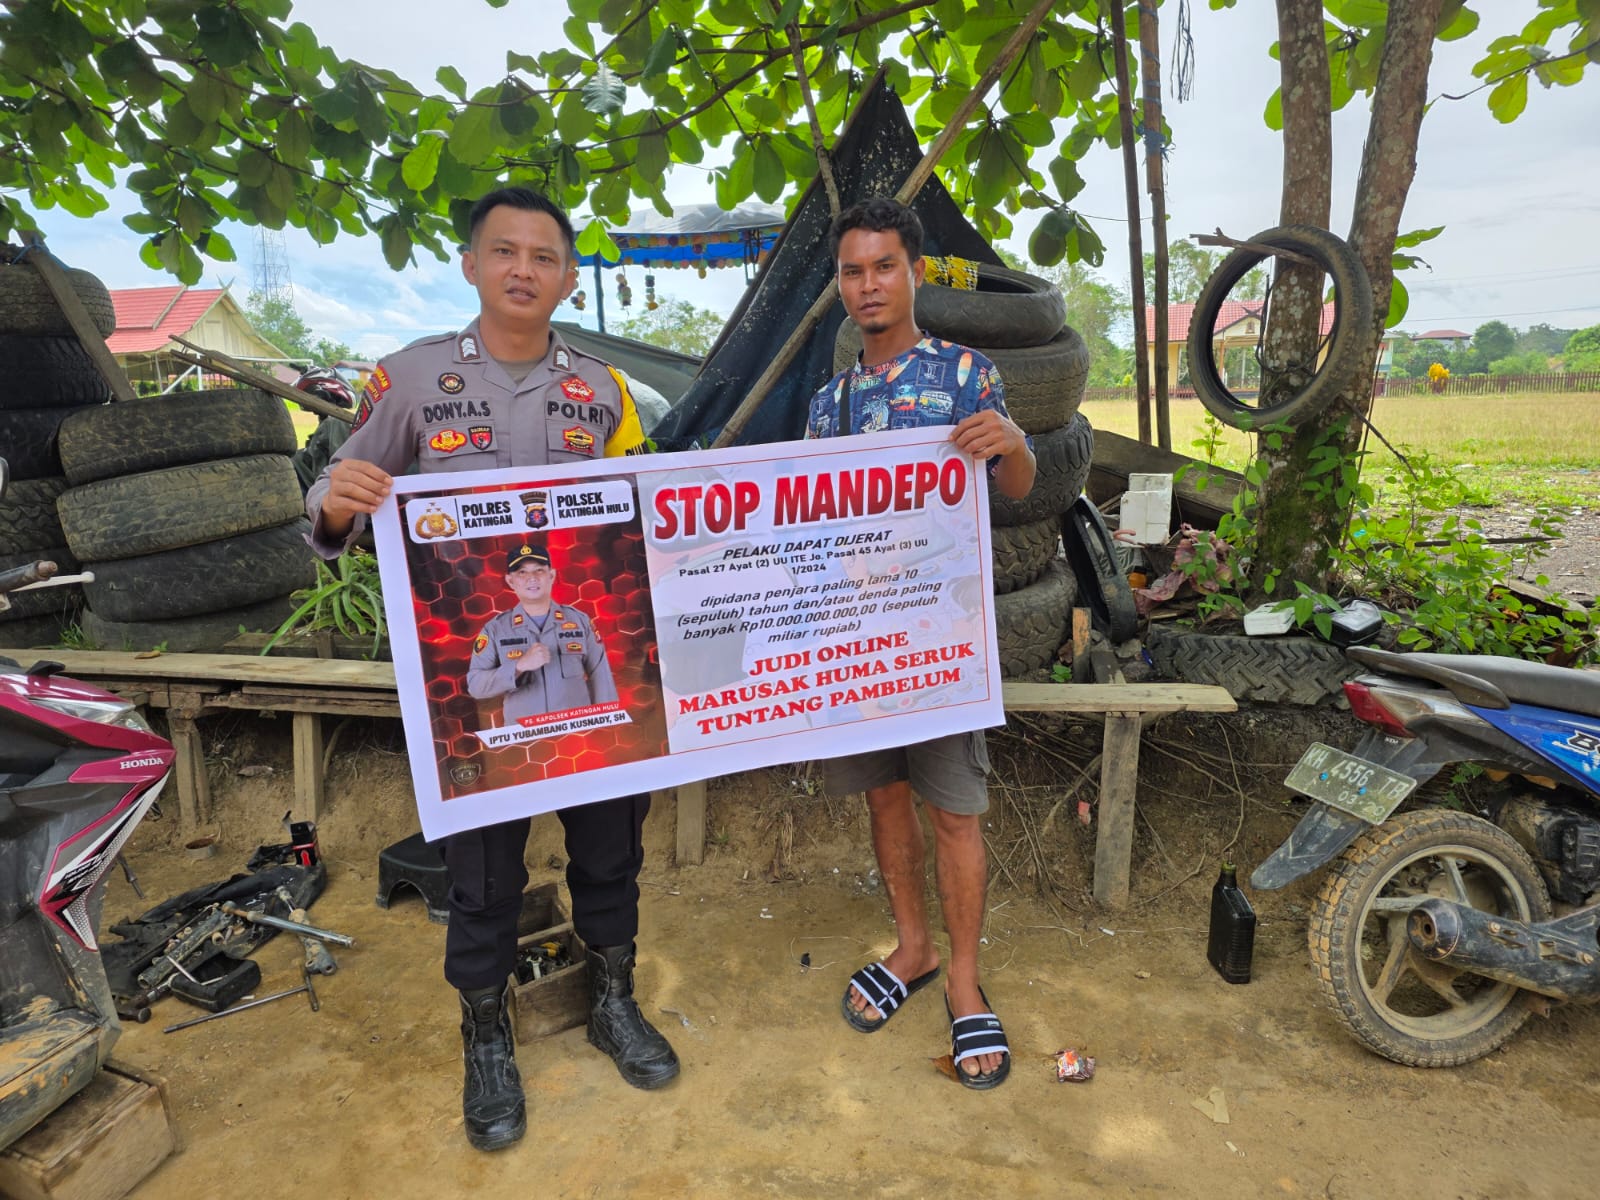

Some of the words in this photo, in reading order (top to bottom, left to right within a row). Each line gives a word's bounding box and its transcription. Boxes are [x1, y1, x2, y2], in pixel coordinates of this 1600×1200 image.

[423, 400, 491, 424] DONY.A.S
[548, 400, 604, 425] POLRI
[461, 501, 511, 517] POLRES
[556, 492, 603, 507] POLSEK
[558, 506, 605, 519] KATINGAN
[606, 503, 630, 514] HULU
[654, 481, 761, 540] STOP
[773, 457, 967, 526] MANDEPO
[464, 514, 513, 529] KATINGAN
[679, 566, 710, 577] Pasal
[713, 564, 725, 573] 27
[729, 561, 752, 572] Ayat
[756, 558, 770, 569] (2)
[773, 557, 788, 565] UU
[791, 554, 807, 563] ITE
[809, 553, 824, 561] Jo.
[827, 549, 856, 559] Pasal
[858, 546, 871, 555] 45
[874, 543, 896, 554] Ayat
[899, 540, 912, 550] (3)
[914, 539, 928, 548] UU
[723, 543, 781, 560] PELAKU
[784, 537, 832, 553] DAPAT
[834, 530, 893, 547] DIJERAT
[791, 563, 827, 575] 1/2024
[700, 592, 761, 608] dipidana
[764, 583, 819, 601] penjara
[821, 579, 864, 594] paling
[867, 573, 900, 585] lama
[904, 569, 918, 579] 10
[677, 606, 744, 627] (sepuluh)
[749, 603, 789, 617] tahun
[793, 594, 854, 610] dan/atau
[858, 585, 898, 601] denda
[900, 581, 943, 596] paling
[683, 623, 736, 640] banyak
[739, 603, 877, 635] Rp10.000.000.000,00
[882, 595, 939, 613] (sepuluh
[767, 628, 810, 643] miliar
[813, 620, 862, 637] rupiah)
[749, 651, 812, 676] JUDI
[816, 631, 909, 663] ONLINE
[678, 675, 811, 715] MARUSAK
[815, 660, 889, 687] HUMA
[893, 642, 976, 671] SERUK
[536, 712, 568, 722] KAPOLSEK
[570, 706, 601, 717] KATINGAN
[602, 703, 619, 711] HULU
[697, 695, 824, 735] TUNTANG
[829, 667, 961, 707] PAMBELUM
[489, 735, 510, 745] IPTU
[512, 721, 568, 739] YUBAMBANG
[570, 715, 612, 729] KUSNADY,
[614, 712, 626, 722] SH
[120, 757, 164, 770] HONDA
[1303, 748, 1329, 769] KH
[1330, 760, 1375, 787] 4556
[1378, 776, 1410, 801] TB
